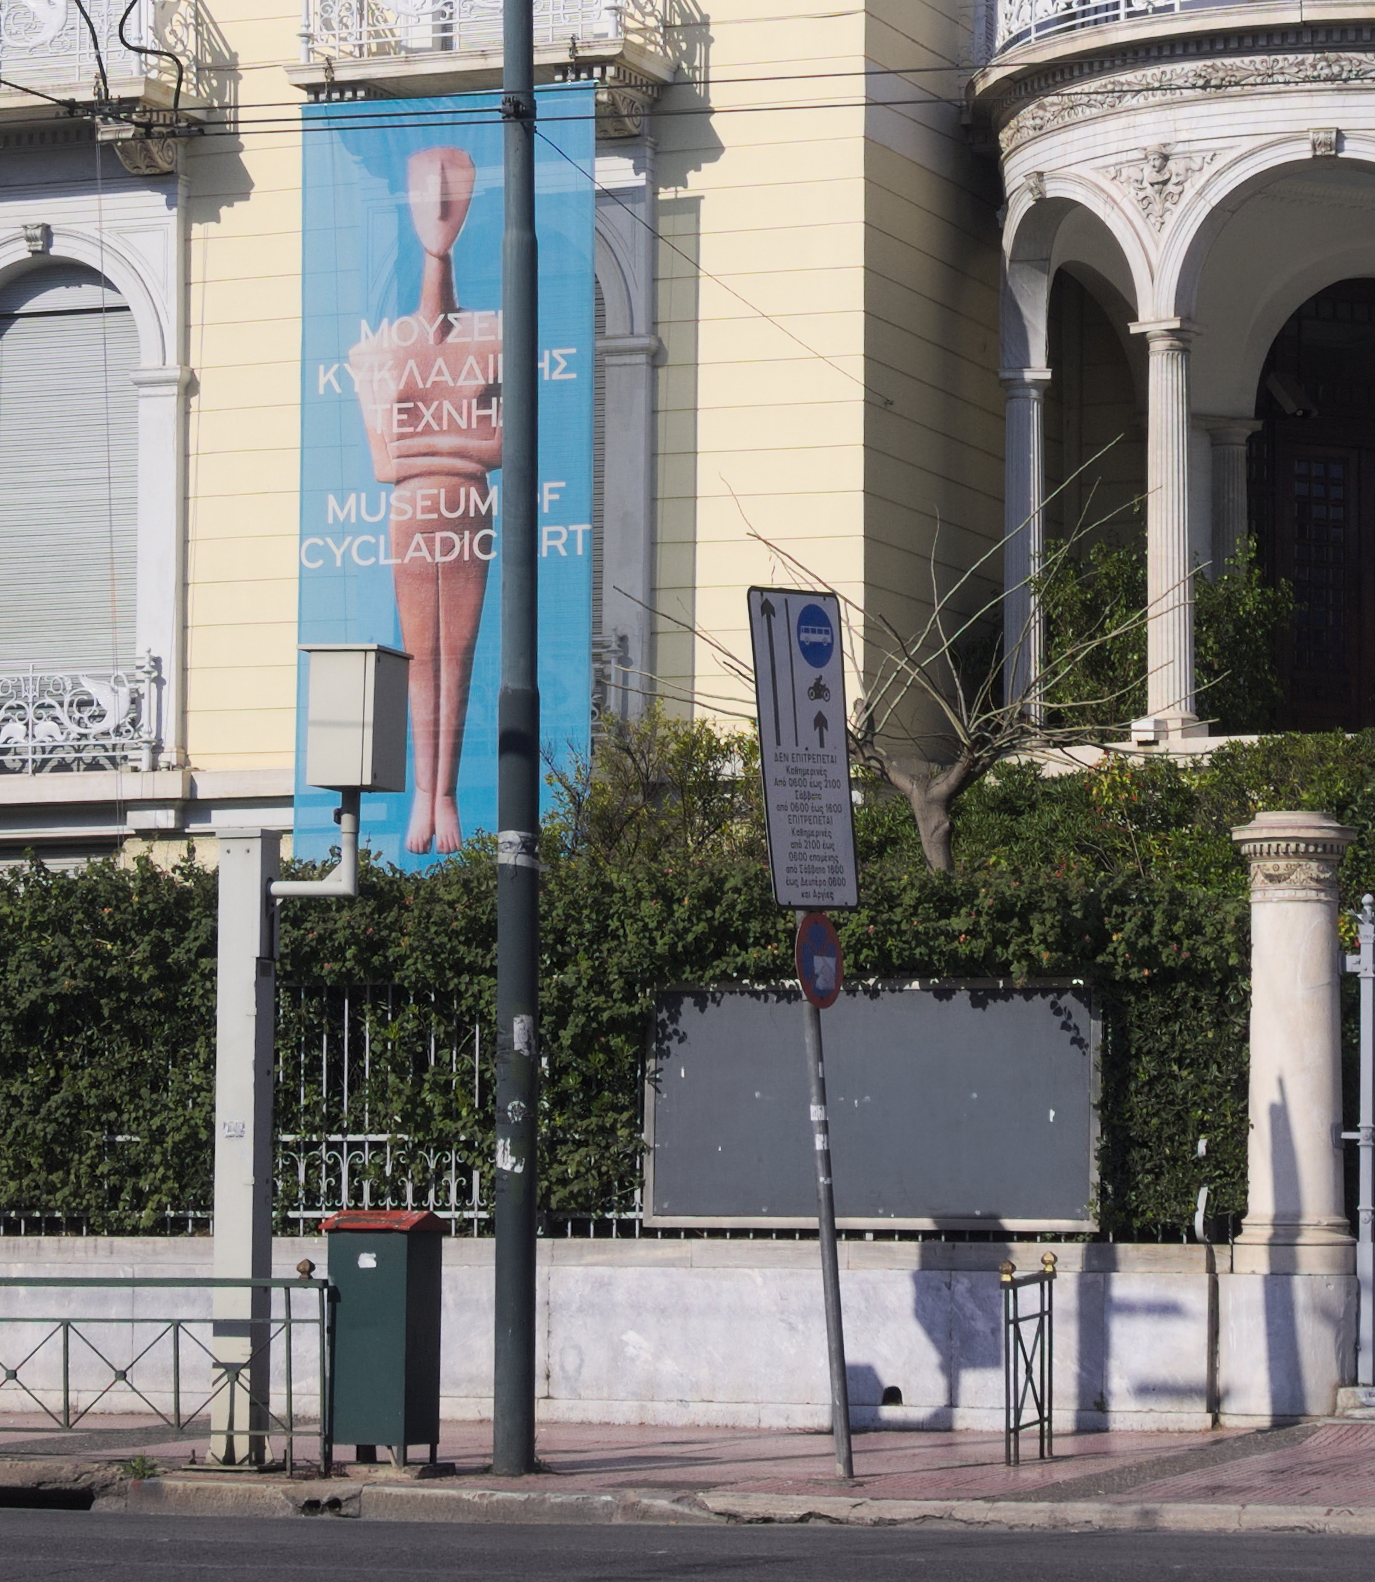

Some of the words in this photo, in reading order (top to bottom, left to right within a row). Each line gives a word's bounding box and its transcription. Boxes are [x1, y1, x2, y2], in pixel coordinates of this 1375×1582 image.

[359, 310, 503, 349] ΜΟΥΣΕΙ
[318, 347, 577, 395] ΚΥΚΛΑΔΙΗΣ
[368, 396, 503, 434] ΤΕΧΝΗ
[327, 485, 498, 524] MUSEUM
[538, 481, 566, 514] F
[300, 529, 498, 569] CYCLADIC
[538, 524, 592, 559] RT
[774, 752, 789, 762] ΔΕΝ
[791, 753, 837, 764] ΕΠΙΤΡΕΠΕΤΑΙ
[787, 814, 833, 825] ΕΠΙΤΡΕΠΕΤΑΙ
